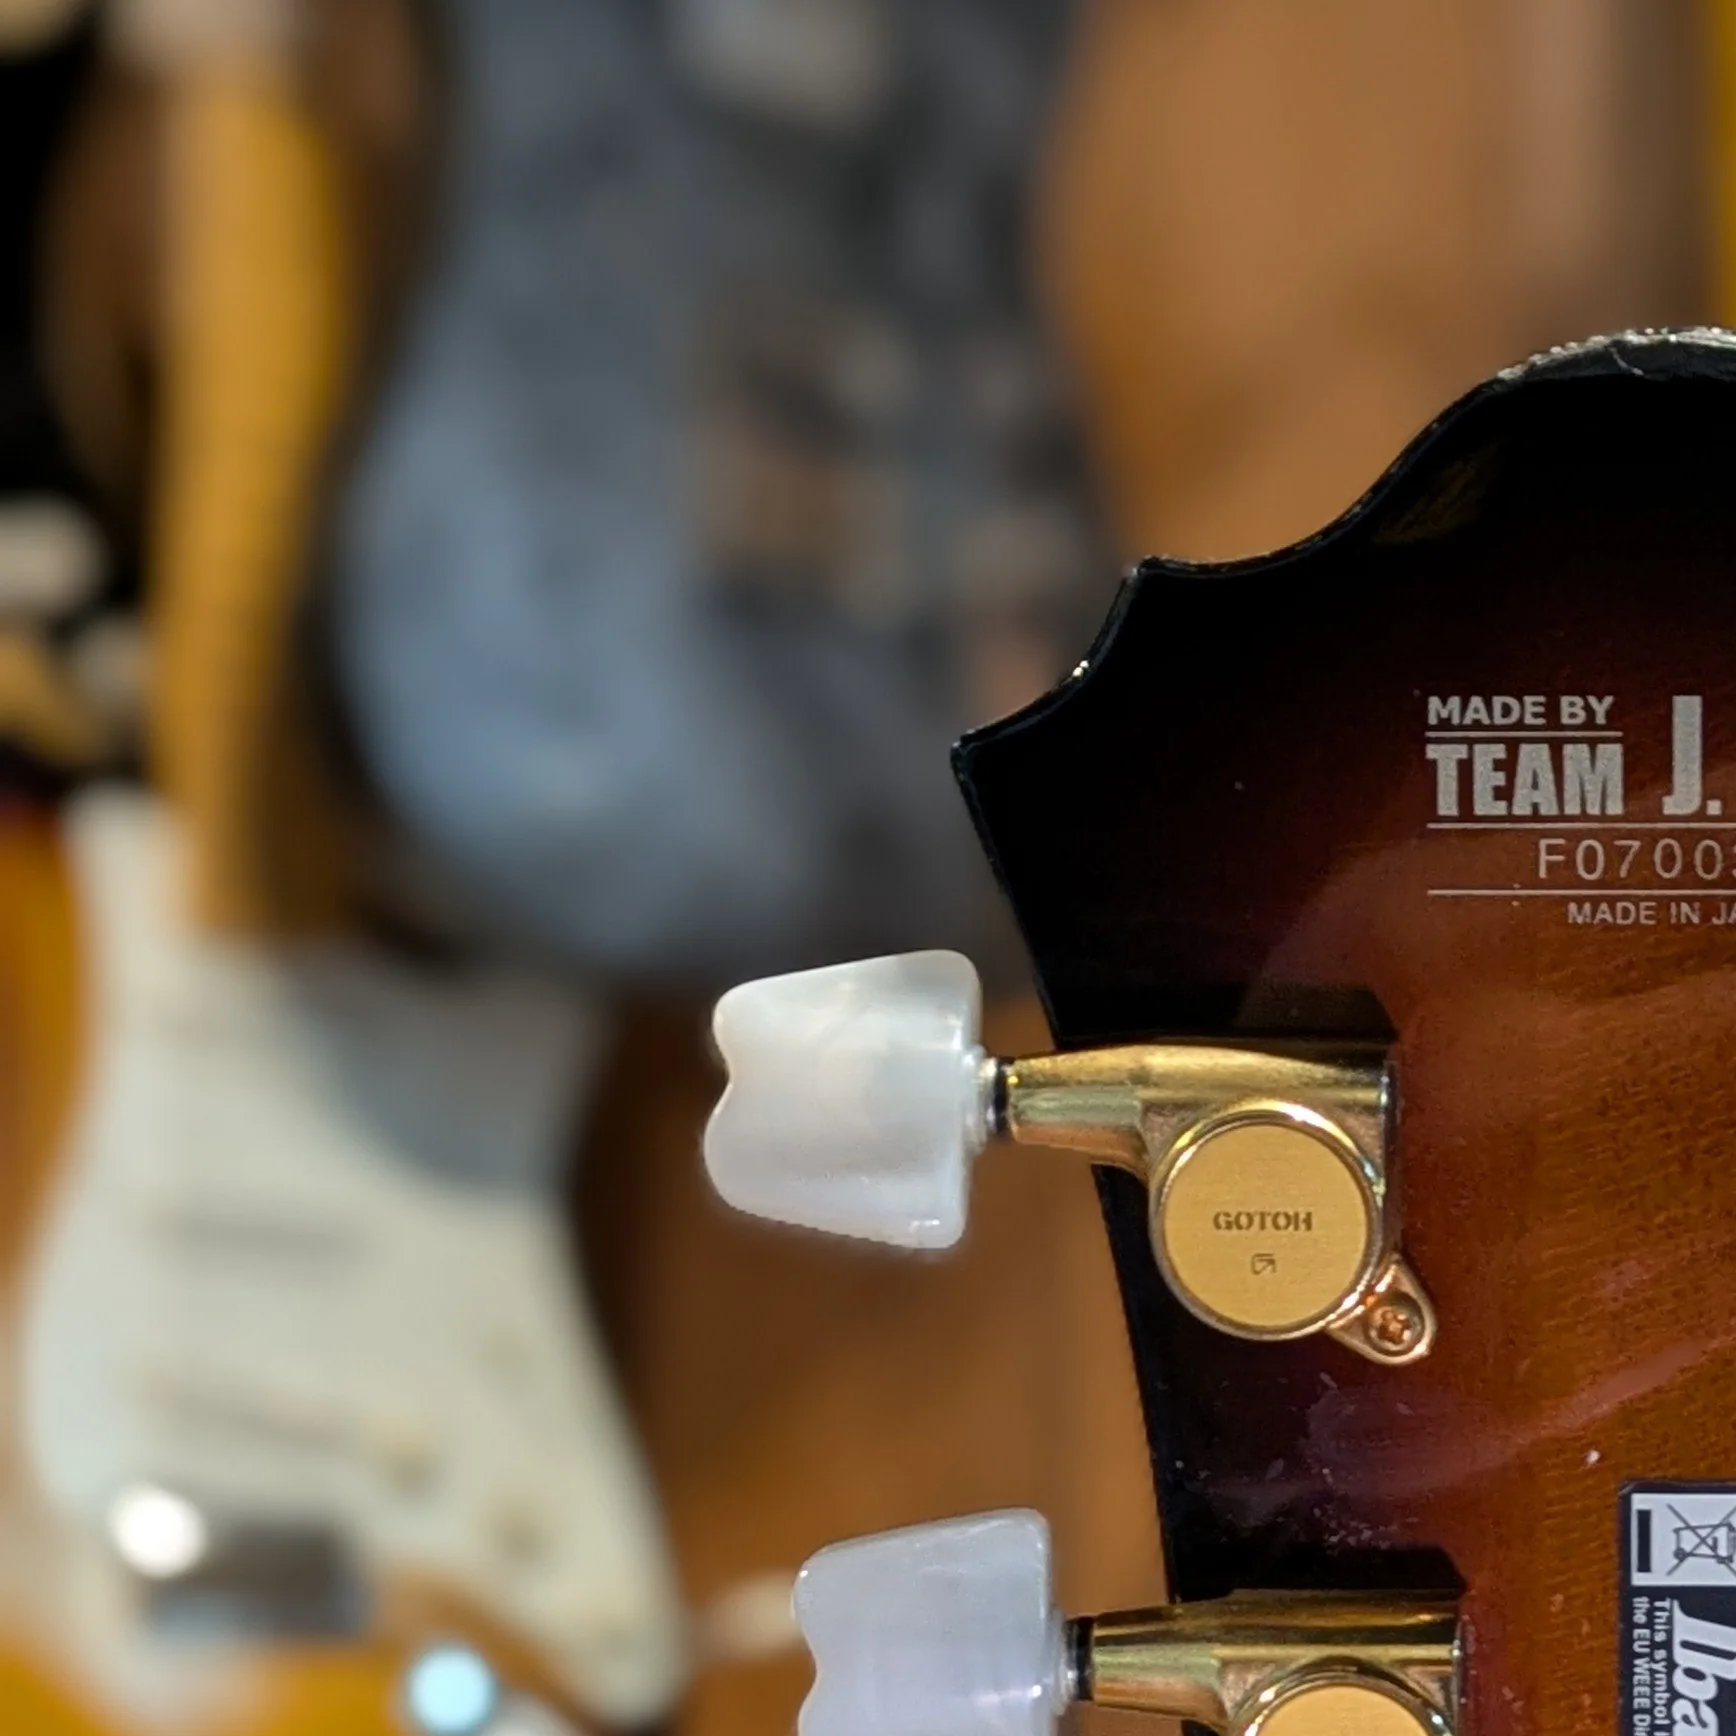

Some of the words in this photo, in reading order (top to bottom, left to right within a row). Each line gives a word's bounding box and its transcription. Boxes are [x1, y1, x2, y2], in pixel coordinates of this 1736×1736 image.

[1428, 696, 1546, 726] MADE
[1560, 696, 1615, 726] BY
[1426, 742, 1624, 817] TEAM
[1662, 695, 1722, 816] J.
[1567, 901, 1657, 926] MADE
[1670, 901, 1701, 926] IN
[1212, 1210, 1314, 1233] GOTOH
[1633, 1596, 1650, 1623] the
[1654, 1597, 1671, 1642] This
[1633, 1628, 1650, 1653] EU
[1633, 1657, 1650, 1709] WEEE
[1651, 1649, 1671, 1725] symbol
